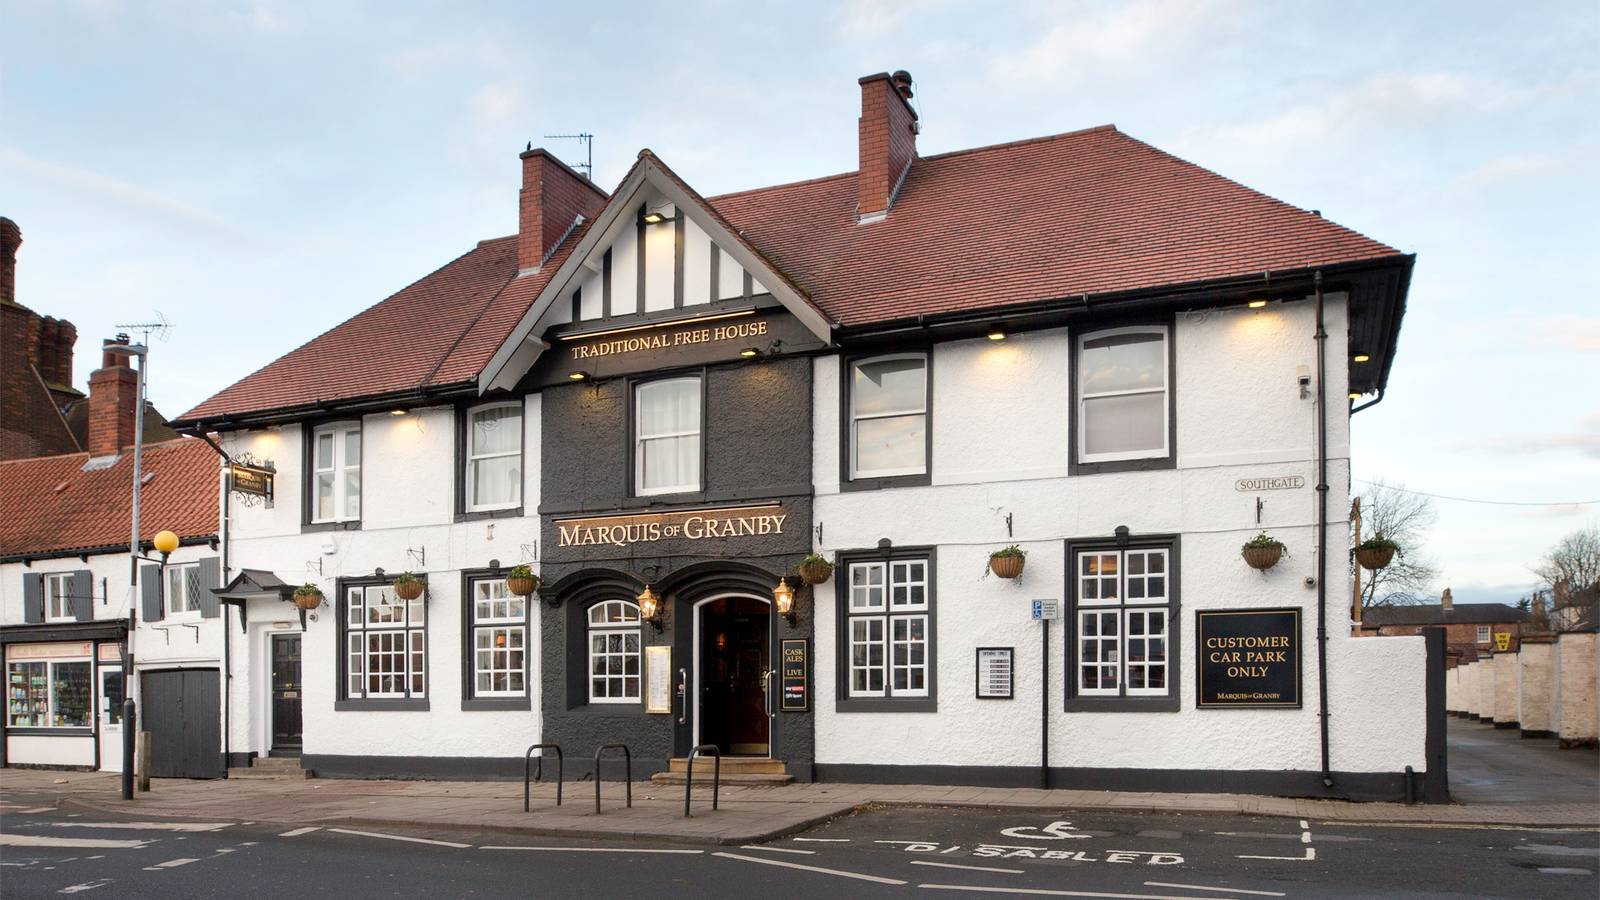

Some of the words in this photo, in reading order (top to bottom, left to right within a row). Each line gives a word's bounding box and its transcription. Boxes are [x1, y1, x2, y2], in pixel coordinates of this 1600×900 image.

[572, 335, 670, 360] TRADITIONAL
[674, 329, 710, 346] FREE
[714, 321, 767, 341] HOUSE
[1240, 477, 1300, 490] SOUTHGATE
[558, 522, 660, 547] MARQUIS
[663, 525, 681, 537] OF
[683, 514, 787, 540] GRANBY
[1207, 636, 1290, 649] CUSTOMER
[785, 648, 804, 656] CASK
[1210, 652, 1241, 664] CAR
[1246, 651, 1287, 663] PARK
[1227, 666, 1270, 678] ONLY
[1216, 692, 1248, 700] MARQUIS
[1253, 692, 1281, 700] GRANBY
[904, 844, 1185, 865] DISABLED
